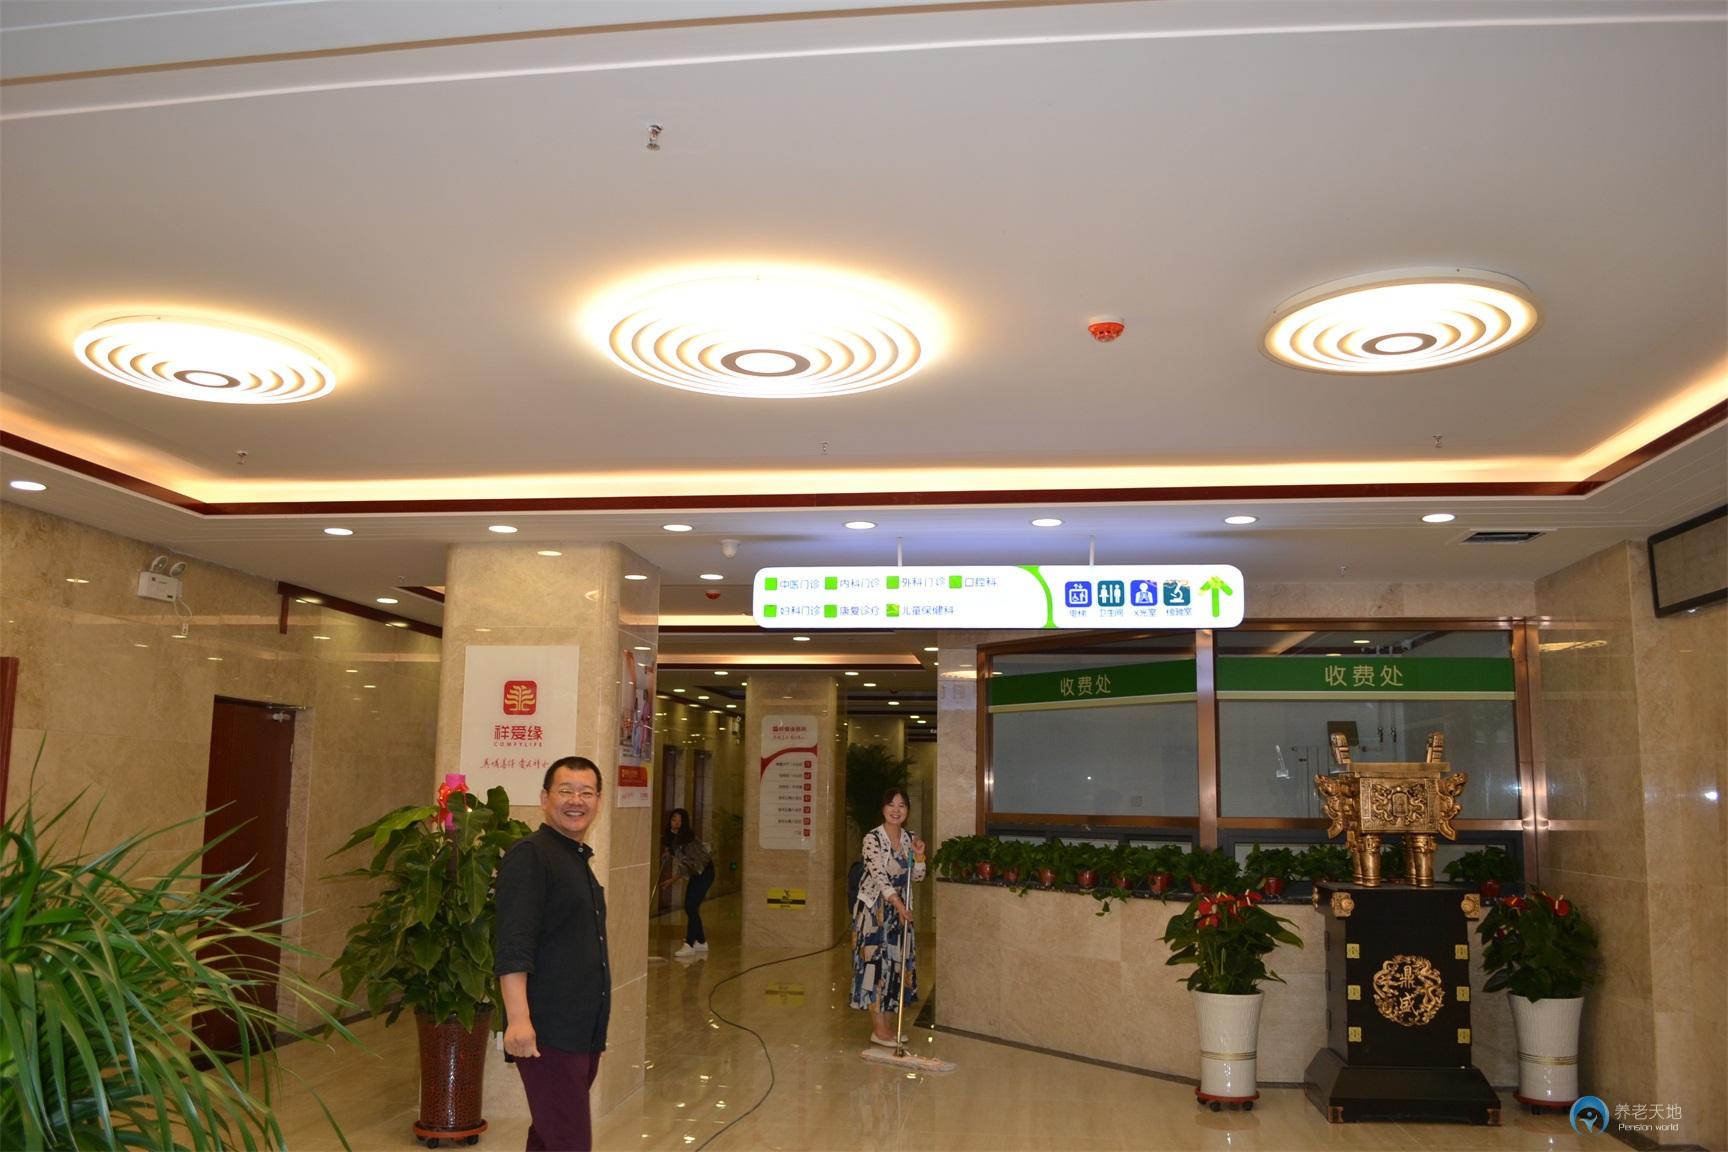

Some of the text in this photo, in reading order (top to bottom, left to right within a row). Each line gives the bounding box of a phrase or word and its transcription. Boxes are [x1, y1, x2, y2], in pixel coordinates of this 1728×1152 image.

[779, 576, 997, 590] 中医门诊 内科门诊 外科门诊 口腔科
[780, 604, 820, 616] 妇科门诊
[901, 604, 954, 616] 儿童保健科
[1325, 664, 1404, 688] 收费处
[1059, 674, 1112, 697] 收费处
[494, 725, 543, 740] 祥爱缘
